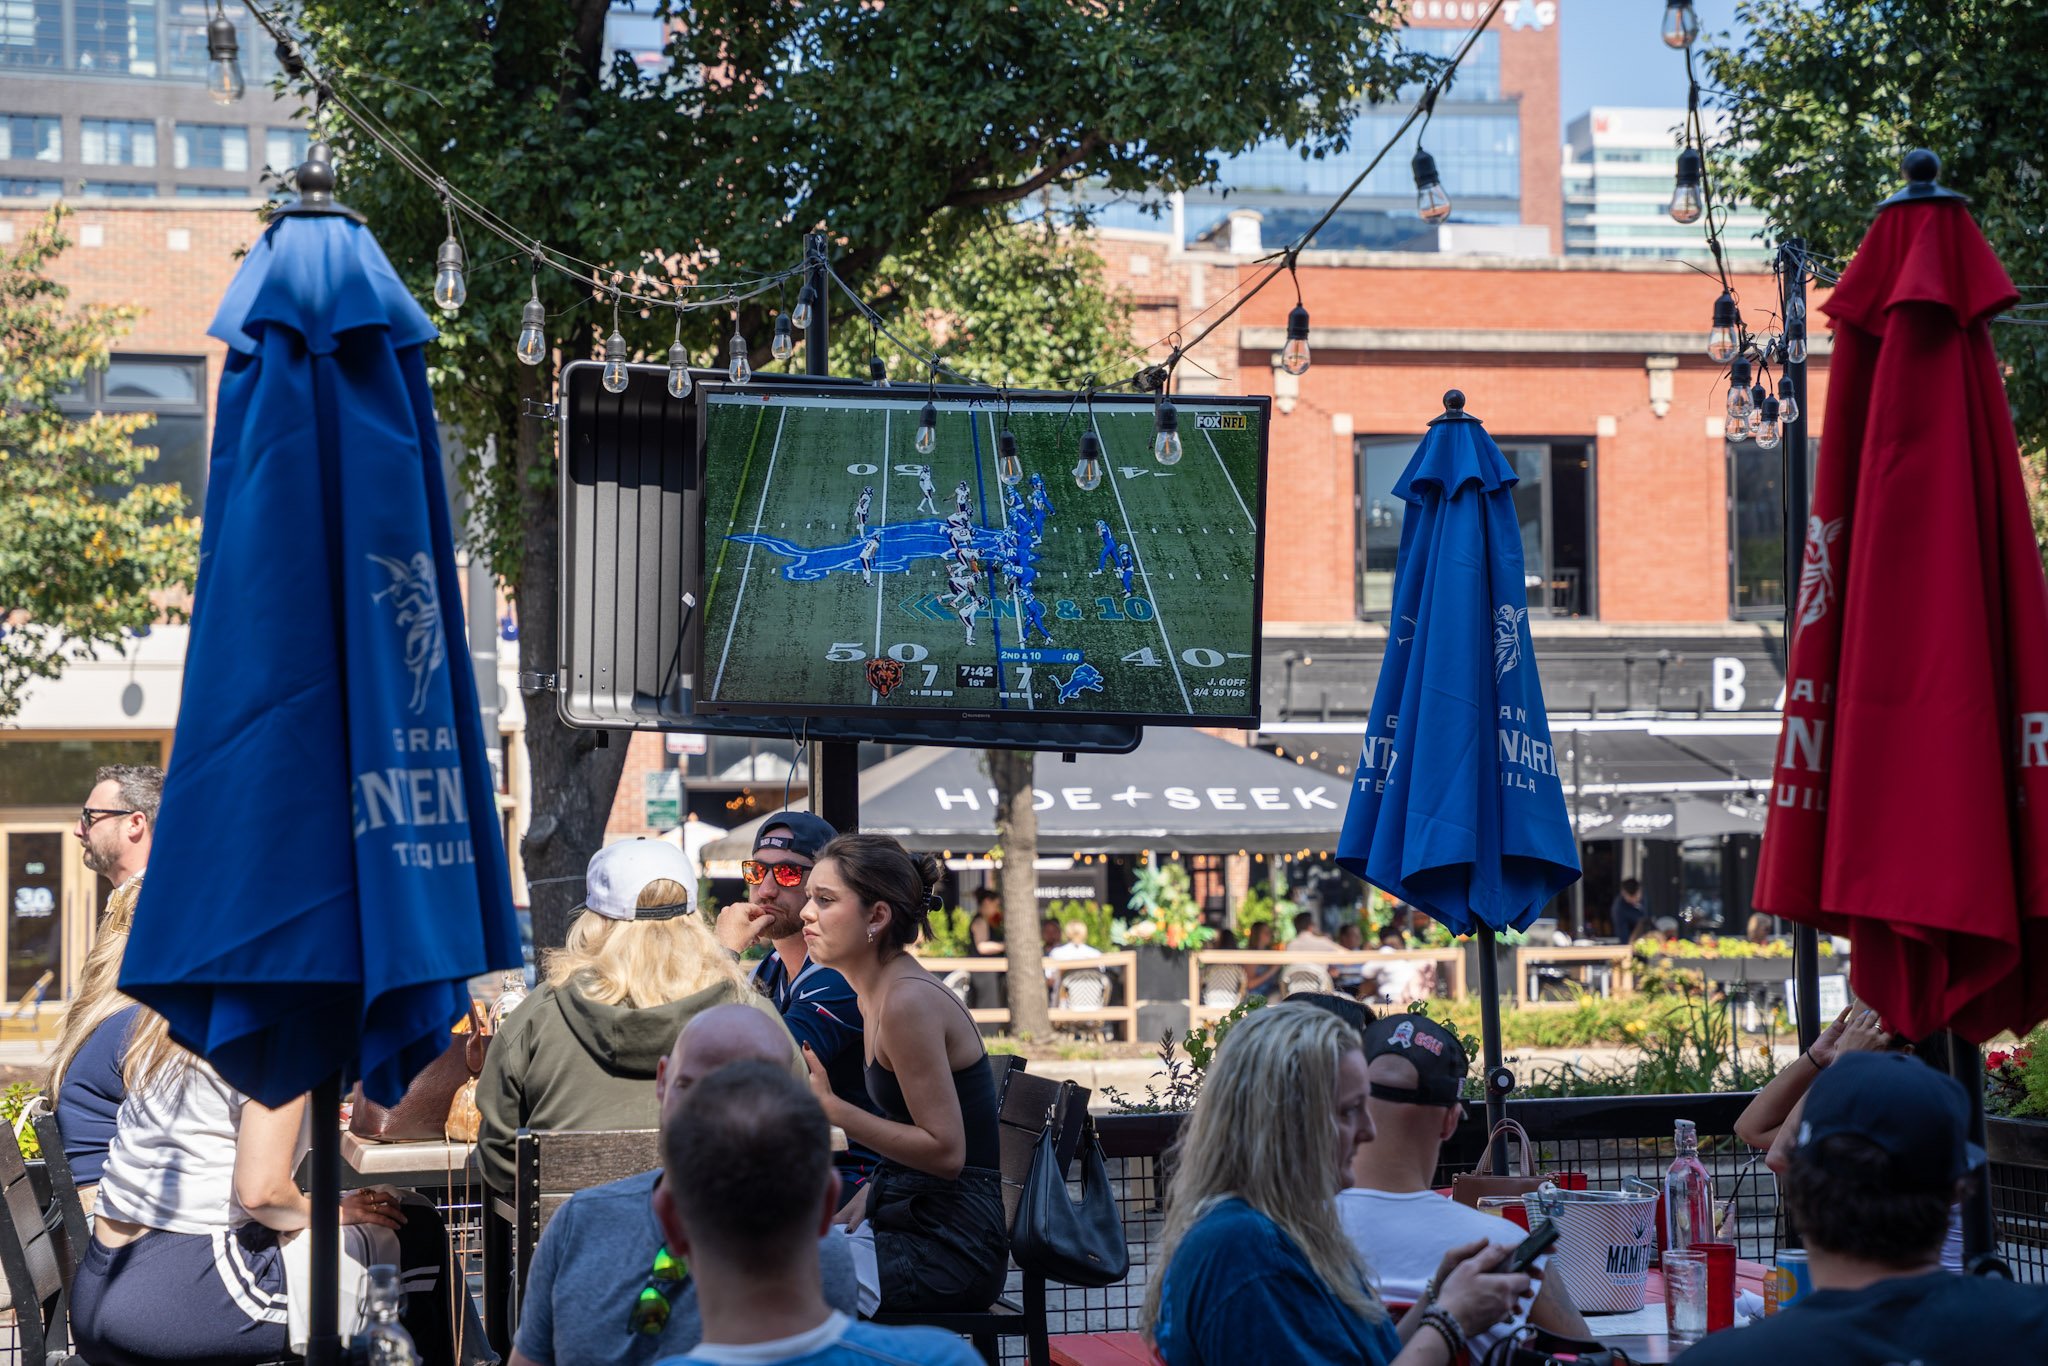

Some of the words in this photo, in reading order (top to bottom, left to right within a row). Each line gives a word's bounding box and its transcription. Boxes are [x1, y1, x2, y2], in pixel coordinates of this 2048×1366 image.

[1196, 416, 1221, 428] FOX
[1222, 416, 1245, 428] NFL
[1055, 599, 1084, 620] &
[1096, 597, 1155, 621] 10
[1001, 651, 1020, 660] 2ND
[1022, 652, 1028, 660] &
[1030, 651, 1042, 660] 10
[1062, 652, 1080, 661] :08
[921, 664, 938, 687] 7
[960, 665, 994, 677] 7:42
[967, 678, 985, 687] 1ST
[1015, 667, 1033, 689] 7
[1207, 678, 1217, 686] J.
[1219, 678, 1246, 686] GOFF
[1193, 688, 1209, 697] 3/4
[1212, 688, 1225, 697] 59
[1226, 688, 1246, 697] YDS
[1163, 786, 1338, 811] SEEK
